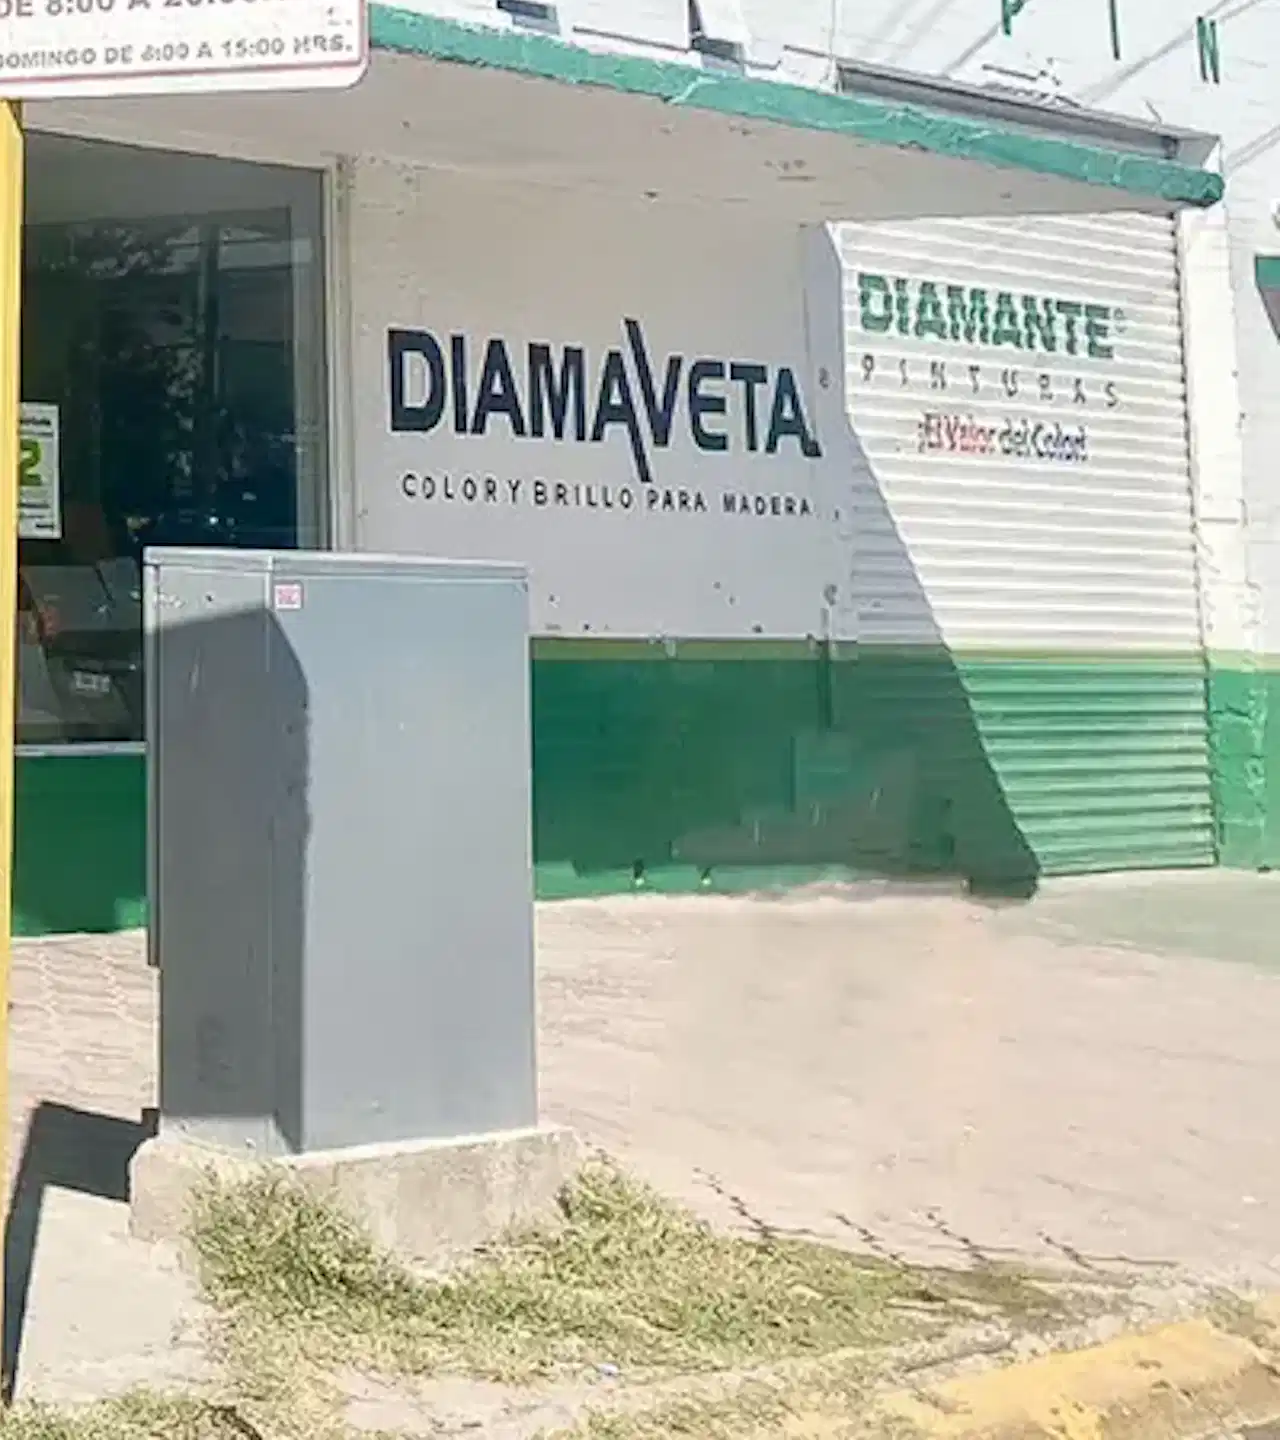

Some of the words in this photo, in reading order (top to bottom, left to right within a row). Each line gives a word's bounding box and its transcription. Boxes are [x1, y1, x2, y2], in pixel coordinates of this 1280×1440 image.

[104, 42, 134, 65] DE
[195, 39, 214, 59] A
[857, 272, 1115, 360] DIAMANTE
[386, 316, 823, 483] DIAMAVETA
[532, 481, 634, 509] BRILLO
[646, 488, 708, 513] PARA
[722, 493, 813, 519] MADERA
